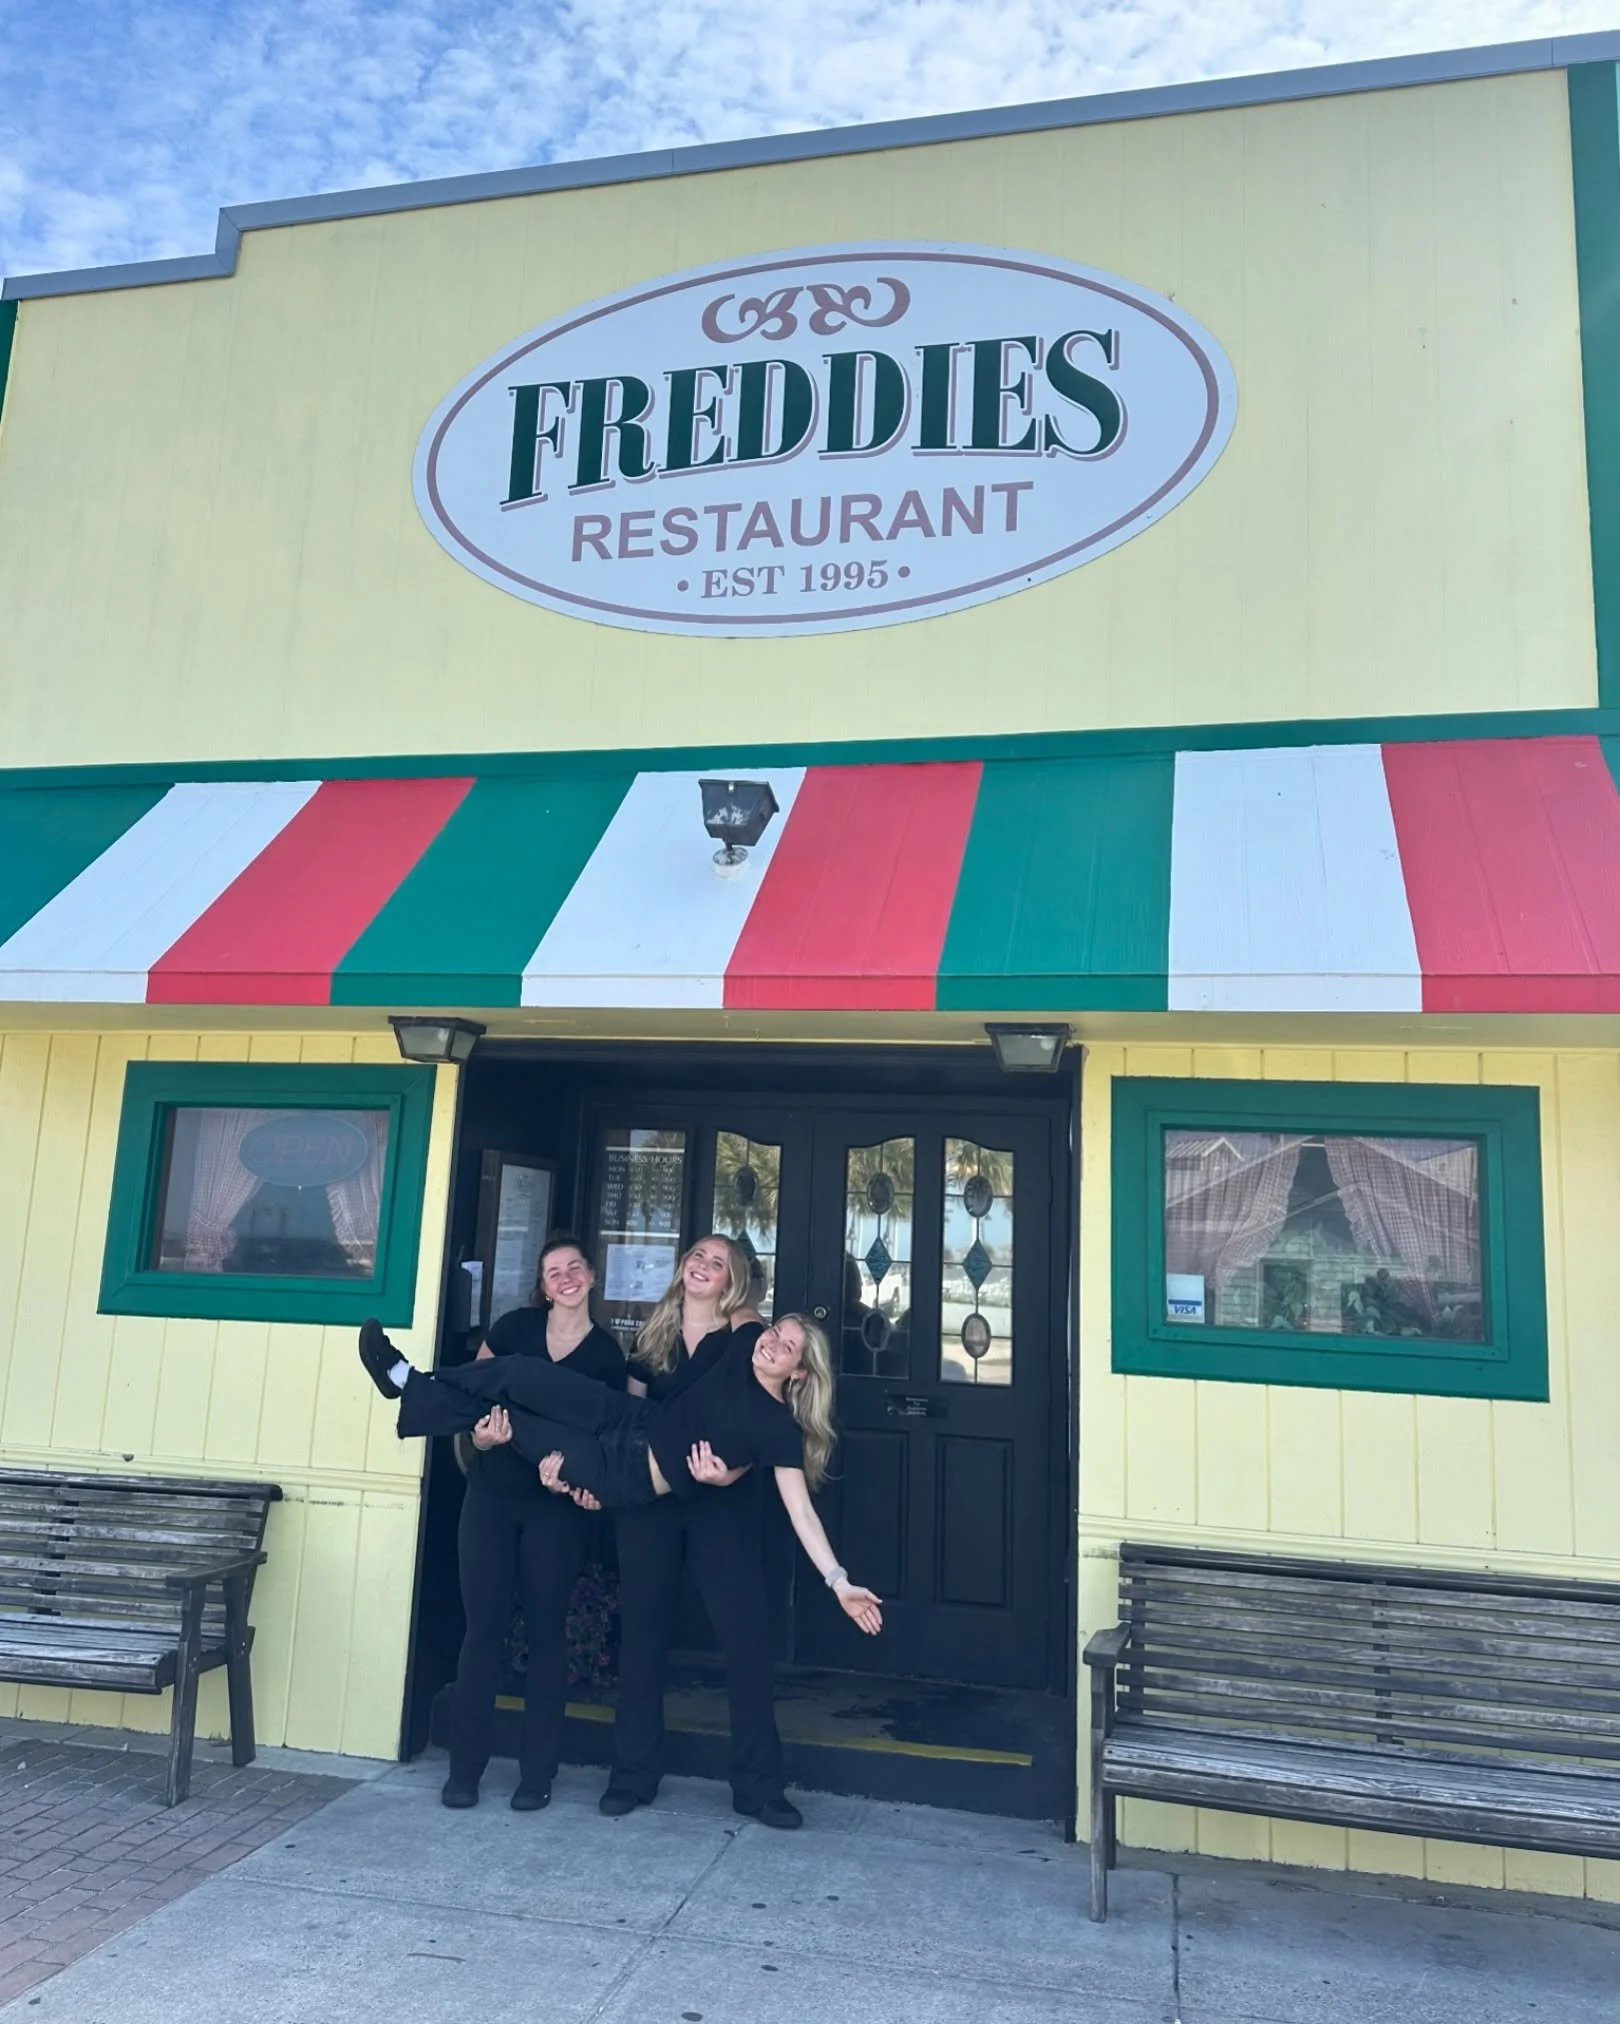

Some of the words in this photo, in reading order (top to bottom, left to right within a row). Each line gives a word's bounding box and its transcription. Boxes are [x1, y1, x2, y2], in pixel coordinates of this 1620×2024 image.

[500, 329, 1128, 510] FREDDIES
[571, 481, 1034, 562] RESTAURANT
[701, 566, 785, 598] EST
[800, 560, 889, 593] 1995
[250, 1132, 356, 1168] OPEN
[608, 1153, 648, 1163] BUSINESS
[651, 1155, 682, 1164] HOURS
[1174, 1305, 1197, 1315] VISA
